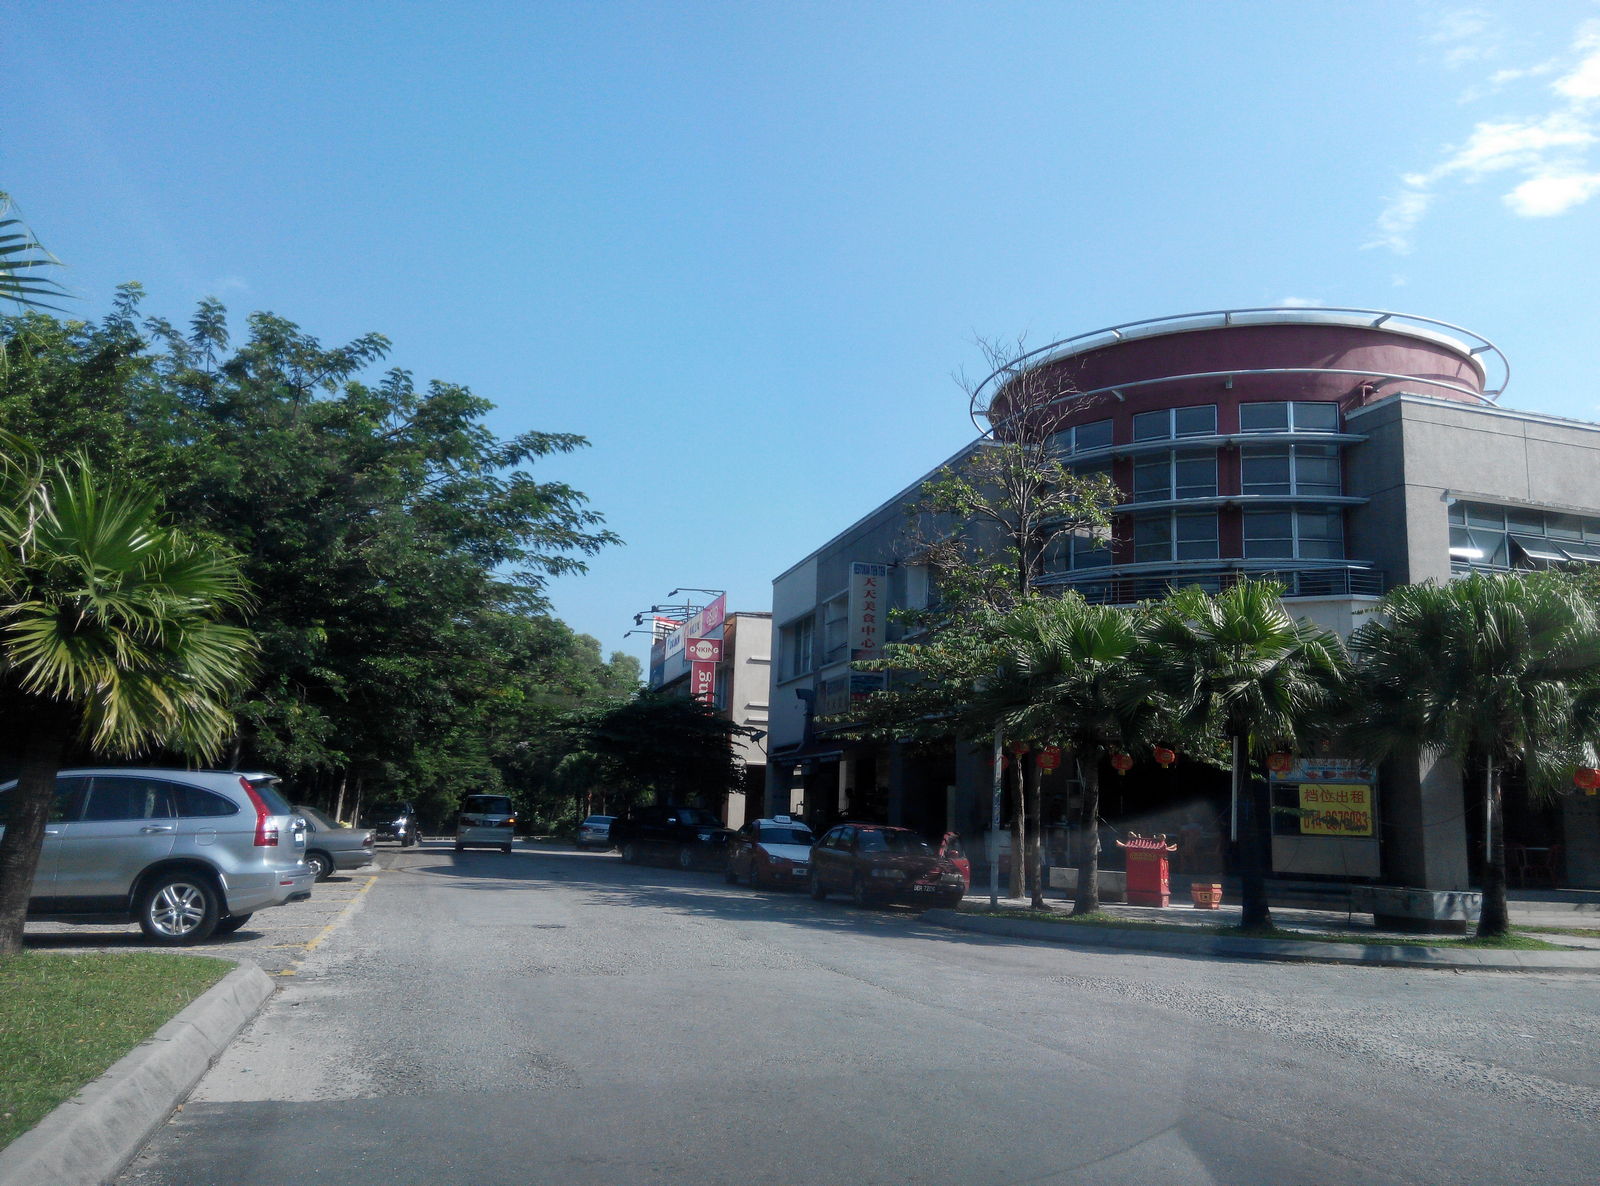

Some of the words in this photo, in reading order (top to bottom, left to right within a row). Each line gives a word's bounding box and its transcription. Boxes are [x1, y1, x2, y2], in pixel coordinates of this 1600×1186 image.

[860, 577, 877, 649] 天天美食中心
[1304, 789, 1365, 804] 档位出租
